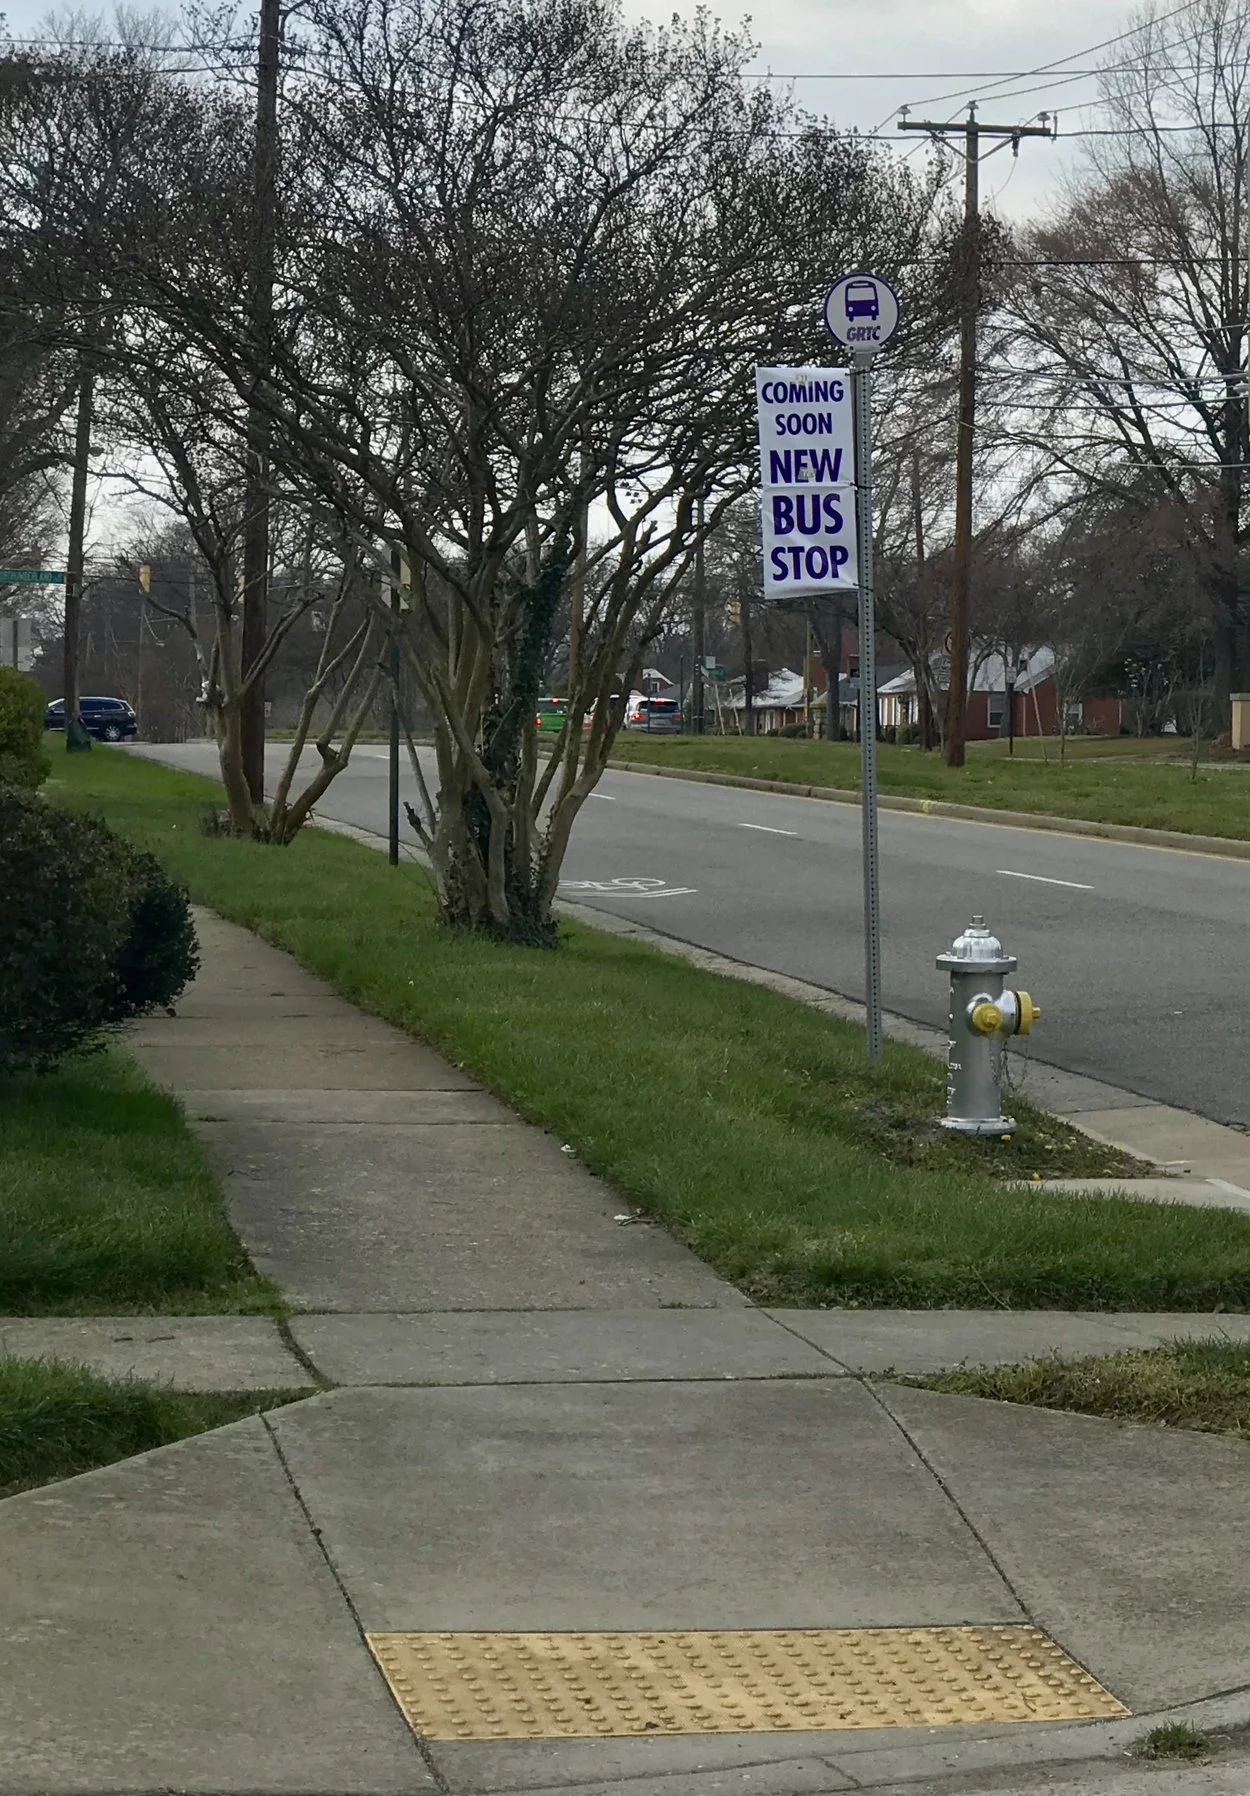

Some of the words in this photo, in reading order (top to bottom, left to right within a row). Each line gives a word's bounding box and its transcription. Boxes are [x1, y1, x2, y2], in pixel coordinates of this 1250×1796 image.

[846, 325, 881, 341] GRTC
[761, 380, 844, 404] COMING
[775, 412, 833, 436] SOON
[770, 448, 843, 484] NEW
[772, 493, 844, 536] BUS
[770, 545, 849, 582] STOP
